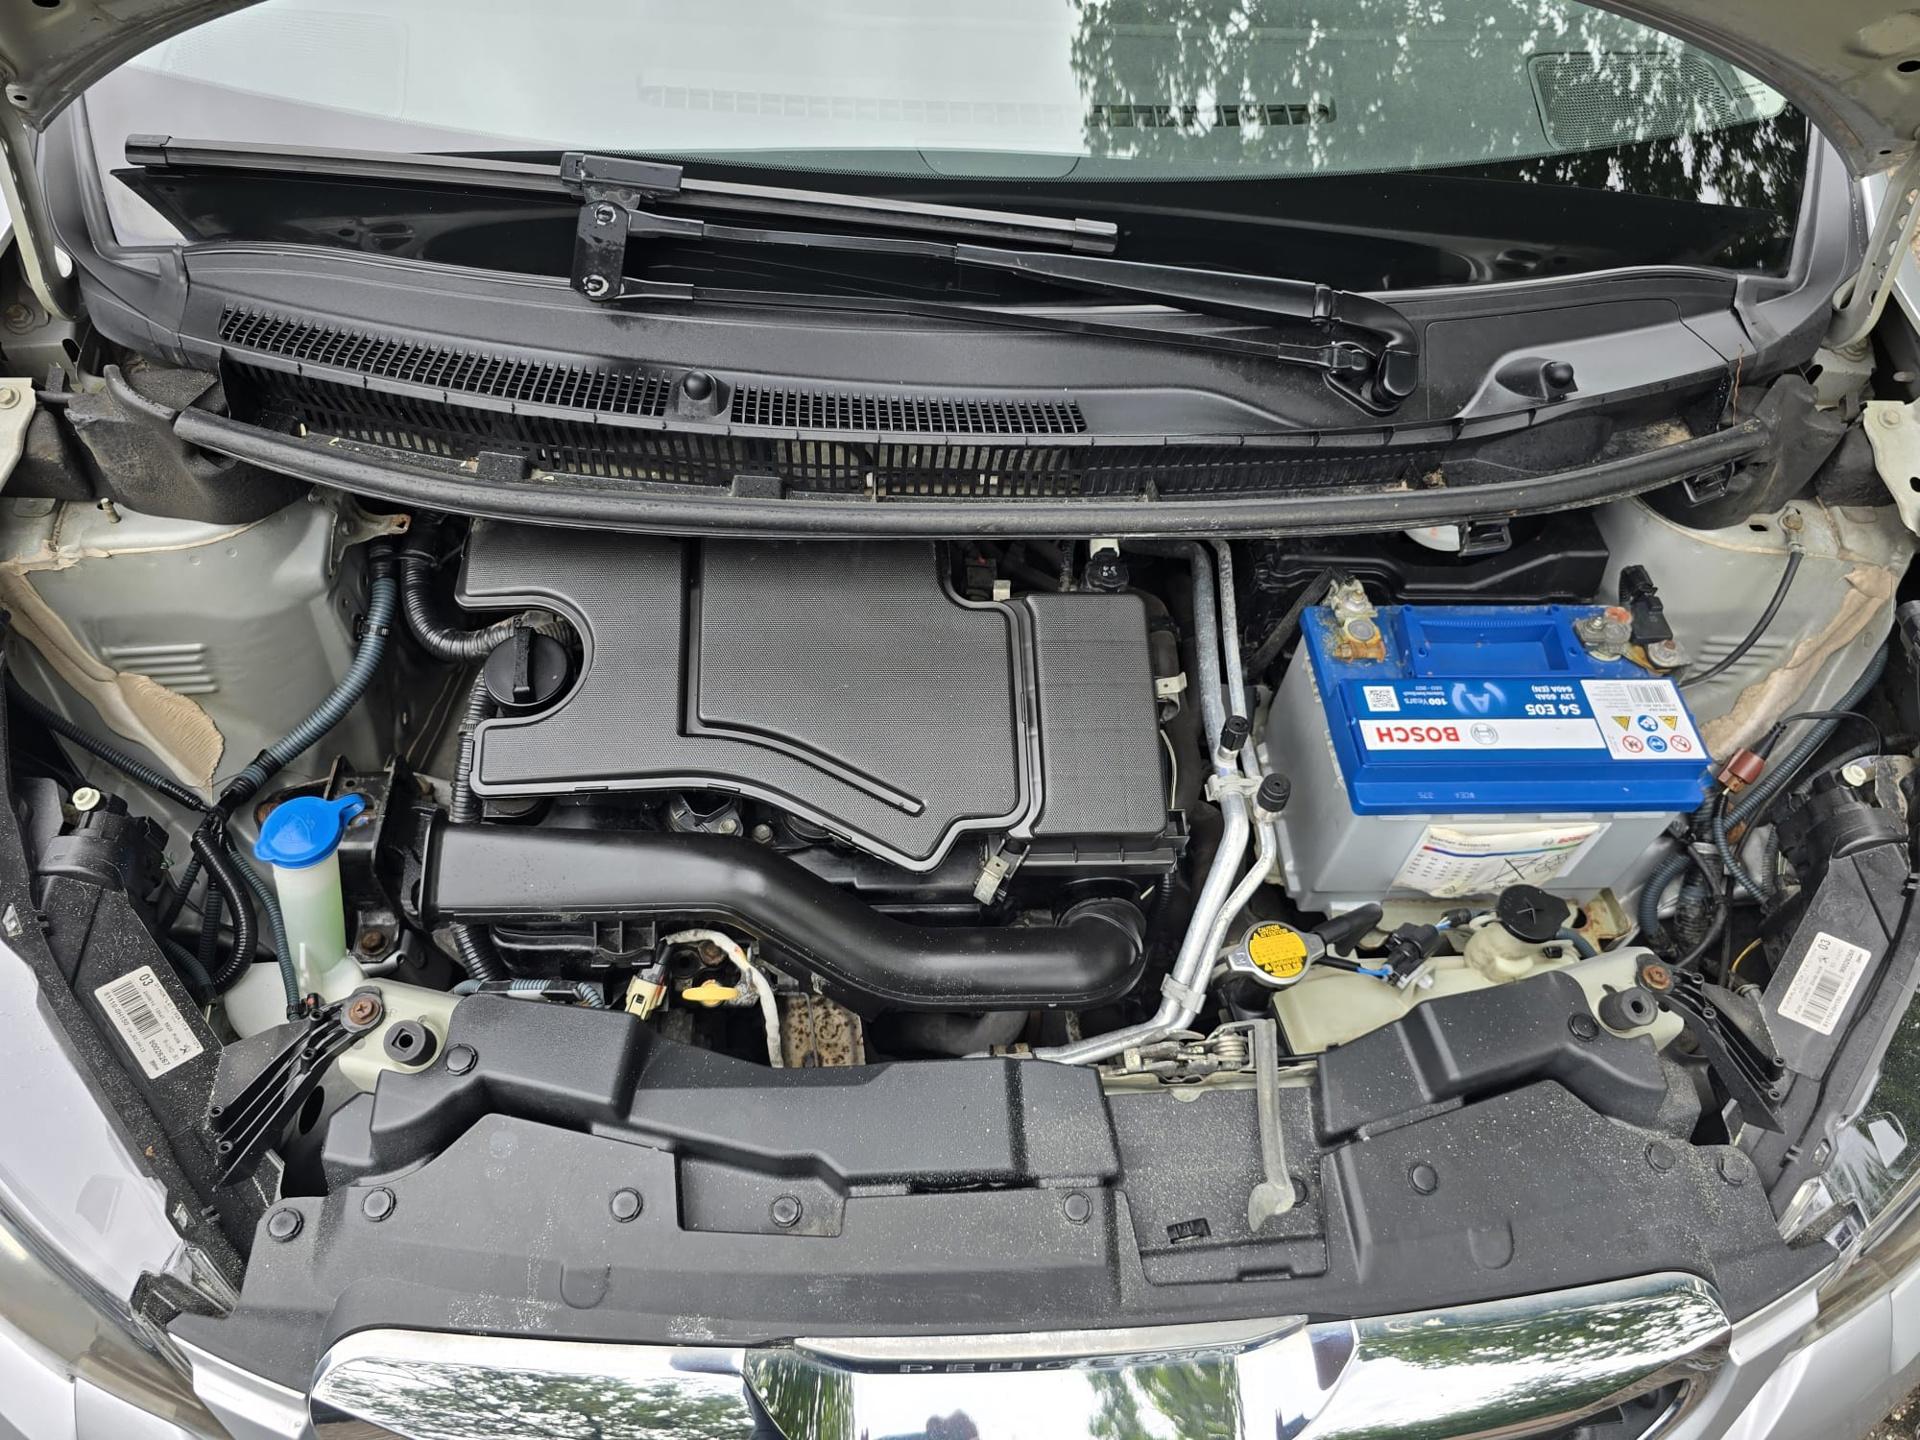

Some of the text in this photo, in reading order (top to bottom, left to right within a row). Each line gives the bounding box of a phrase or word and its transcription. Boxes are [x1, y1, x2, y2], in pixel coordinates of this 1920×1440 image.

[1550, 685, 1573, 693] 640A
[1534, 693, 1557, 701] 60Ah
[1524, 704, 1581, 716] S4 E05
[1375, 726, 1460, 743] BOSCH
[1818, 938, 1831, 951] 03
[139, 973, 153, 986] 03
